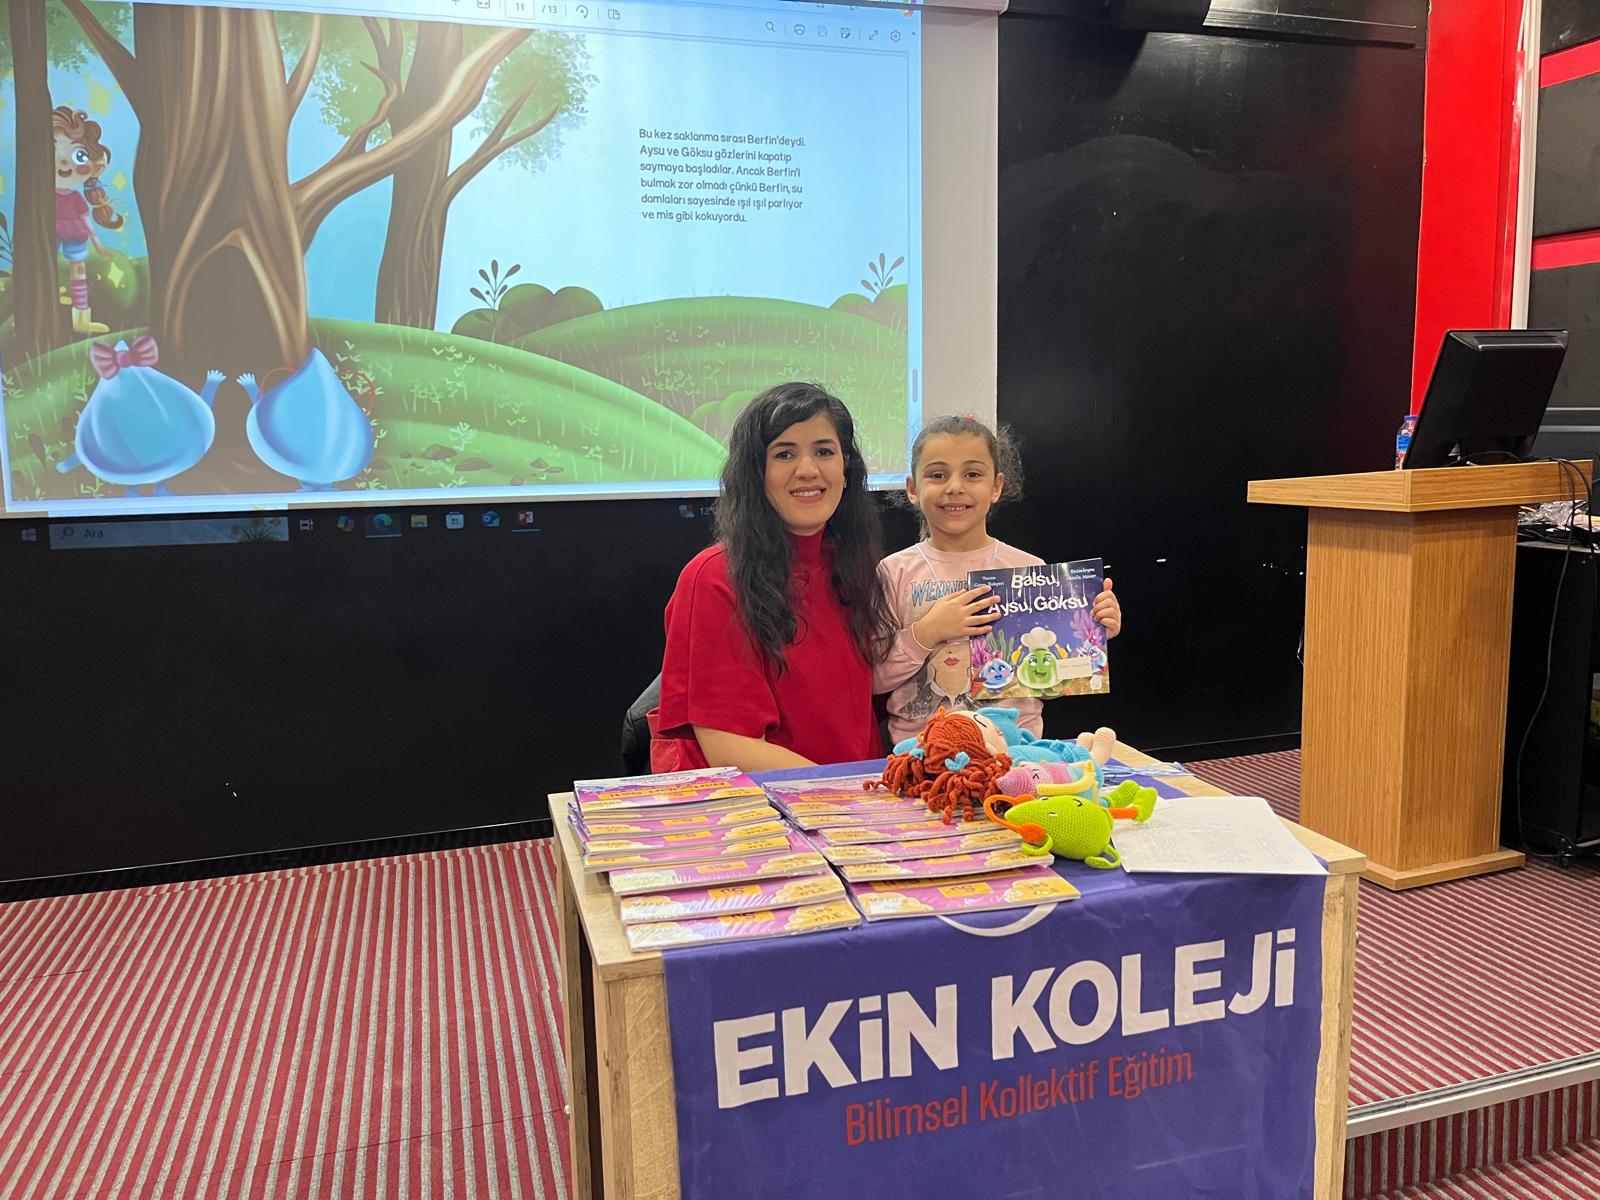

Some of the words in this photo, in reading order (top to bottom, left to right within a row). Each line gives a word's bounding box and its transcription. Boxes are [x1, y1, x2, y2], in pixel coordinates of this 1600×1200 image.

[515, 2, 525, 12] 11
[548, 5, 558, 14] 13
[639, 128, 653, 139] Bu
[654, 129, 673, 140] kez
[673, 131, 719, 142] saklanma
[720, 134, 746, 144] sırası
[747, 134, 806, 148] Berfin'deydi.
[640, 144, 665, 158] Aysu
[666, 147, 679, 157] ve
[681, 147, 713, 158] Göksu
[715, 148, 756, 161] gözlerini
[758, 151, 792, 164] kapatıp
[640, 162, 684, 175] saymaya
[685, 163, 735, 177] başladılar.
[736, 165, 765, 176] Ancak
[767, 166, 801, 178] Berfin'i
[640, 177, 676, 189] bulmak
[678, 181, 694, 190] zor
[696, 180, 728, 190] olmadı
[729, 181, 758, 194] çünkü
[759, 182, 790, 194] Berfin,
[791, 185, 803, 193] su
[641, 193, 686, 205] damlaları
[687, 195, 736, 208] sayesinde
[737, 197, 751, 210] ışıl
[753, 197, 767, 210] ışıl
[768, 198, 803, 211] parlıyor
[642, 211, 655, 219] ve
[656, 209, 674, 220] mis
[675, 210, 693, 223] gibi
[695, 211, 748, 223] kokuyordu.
[83, 528, 104, 538] Ara
[1011, 571, 1060, 589] Balsu,
[1034, 593, 1089, 612] Göksu
[846, 1086, 969, 1146] Bilimsel
[979, 1058, 1100, 1121] Kollektif
[1107, 1047, 1194, 1101] Eğitim
